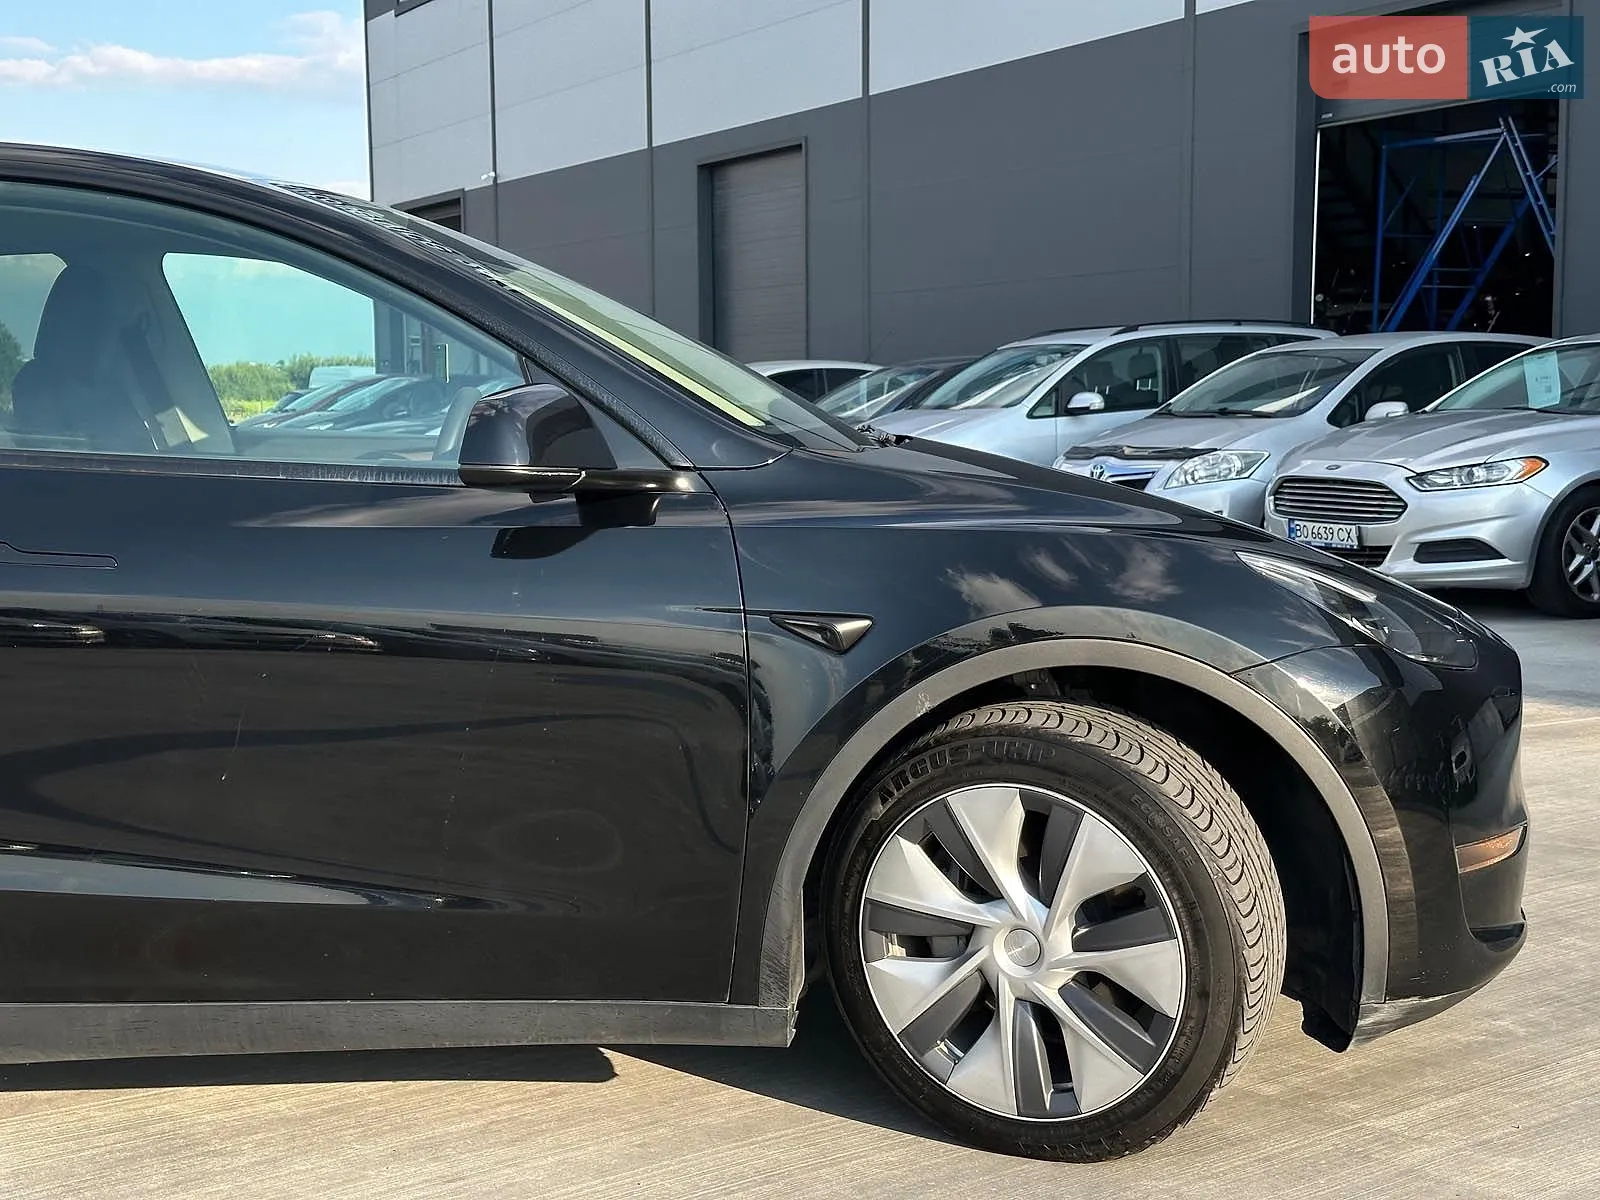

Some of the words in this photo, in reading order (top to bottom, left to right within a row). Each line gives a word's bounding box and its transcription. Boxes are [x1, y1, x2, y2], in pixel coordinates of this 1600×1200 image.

[1295, 523, 1309, 539] BO
[1311, 525, 1335, 541] 6639
[1337, 527, 1354, 543] CX
